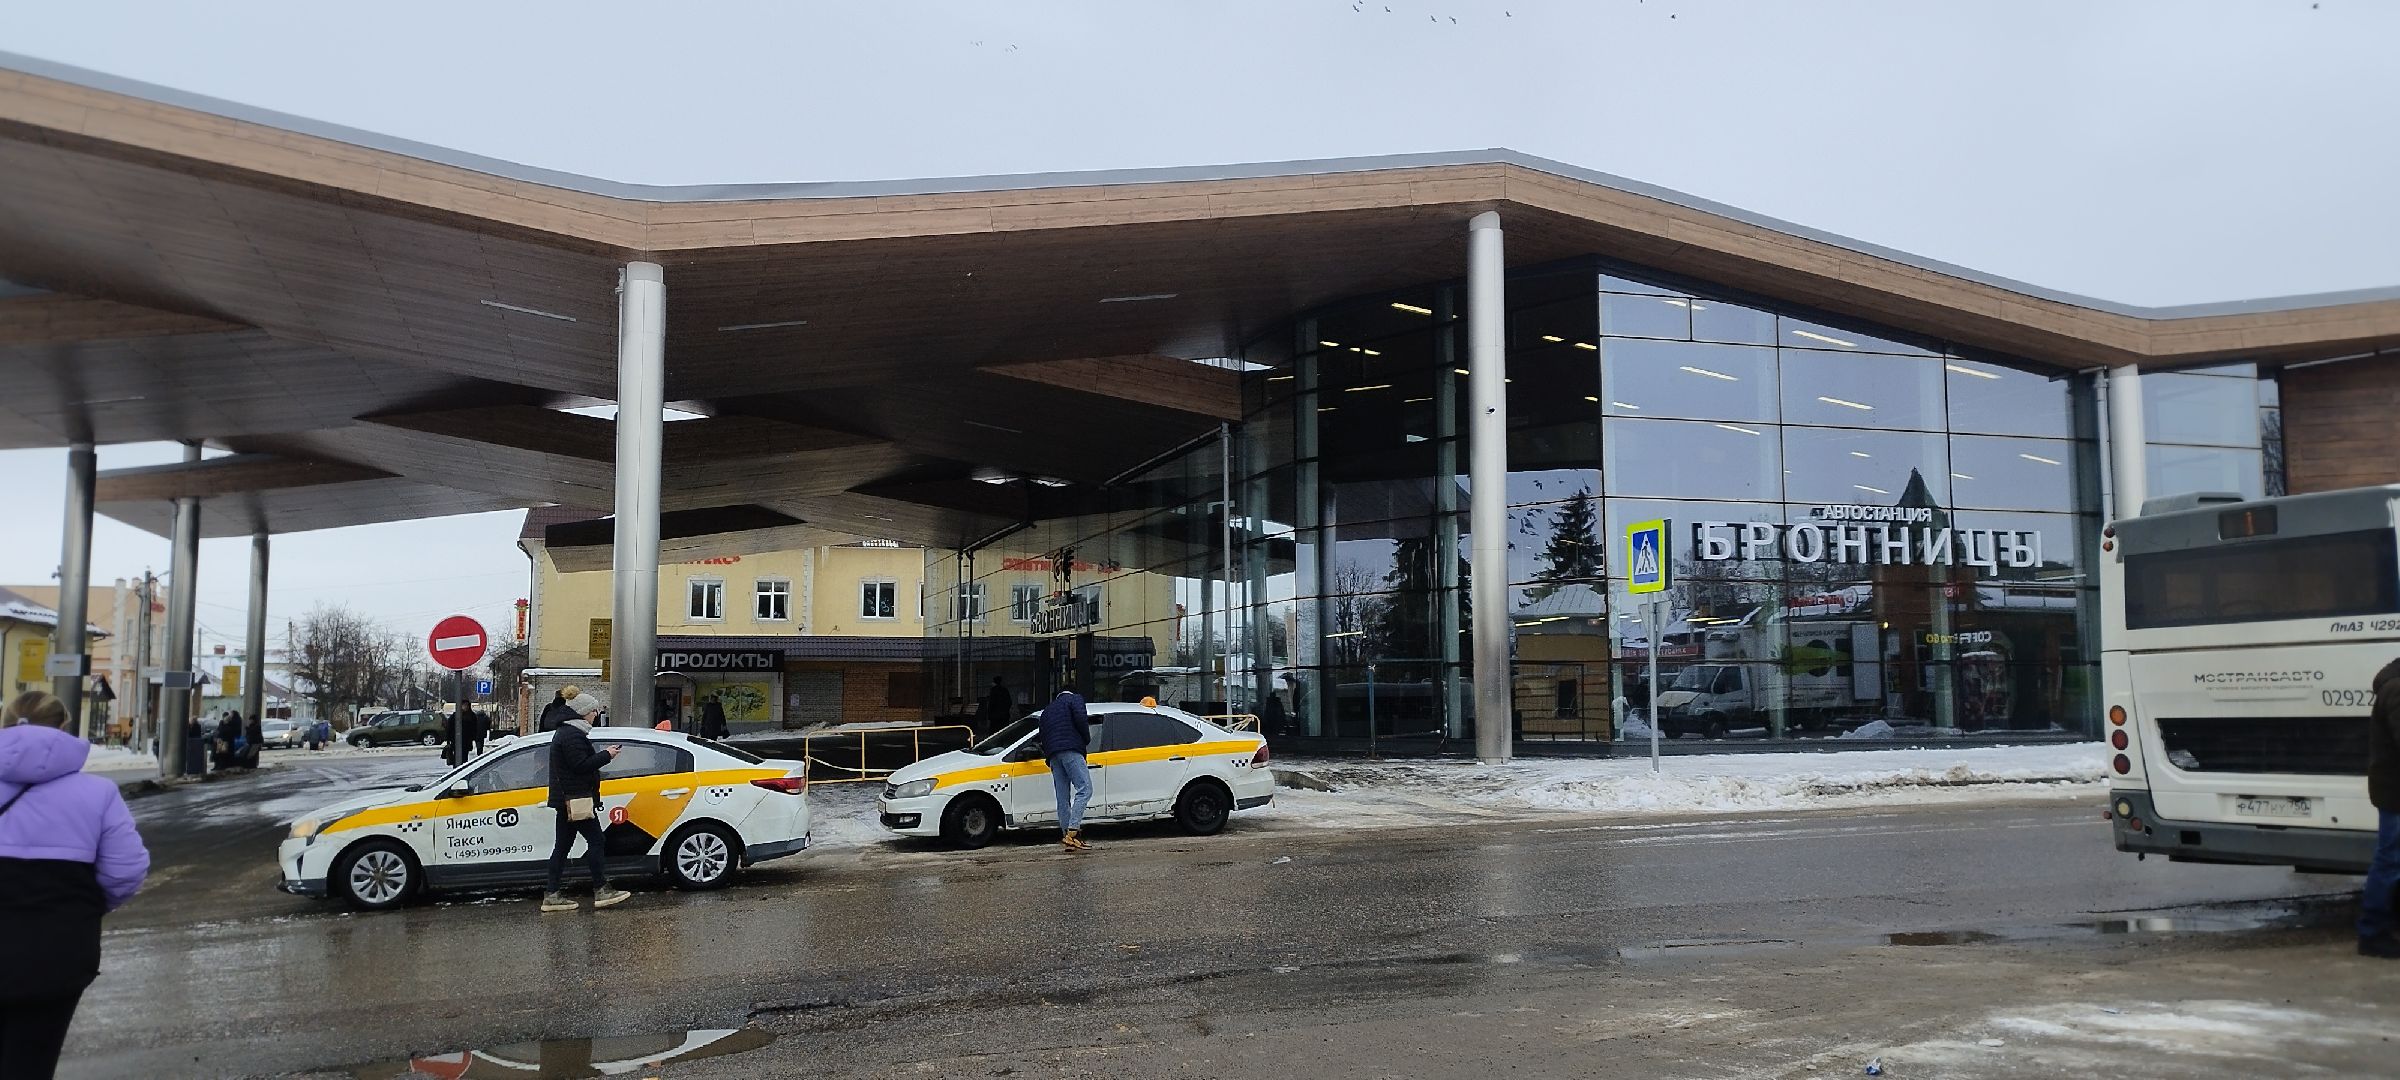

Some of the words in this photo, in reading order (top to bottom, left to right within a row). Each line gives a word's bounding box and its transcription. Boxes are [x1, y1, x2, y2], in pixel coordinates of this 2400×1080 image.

[1823, 505, 1932, 524] АВТОСТАНЦИЯ
[1703, 521, 2043, 577] БРОННИЦЫ
[661, 653, 773, 668] ПРОДУКТЫ
[2195, 671, 2324, 683] МОСТРАНСАВТО
[446, 815, 493, 830] Яндекс
[499, 811, 517, 825] Go
[447, 836, 484, 848] Такси
[455, 848, 480, 859] (495)
[482, 844, 533, 857] 999-99-99
